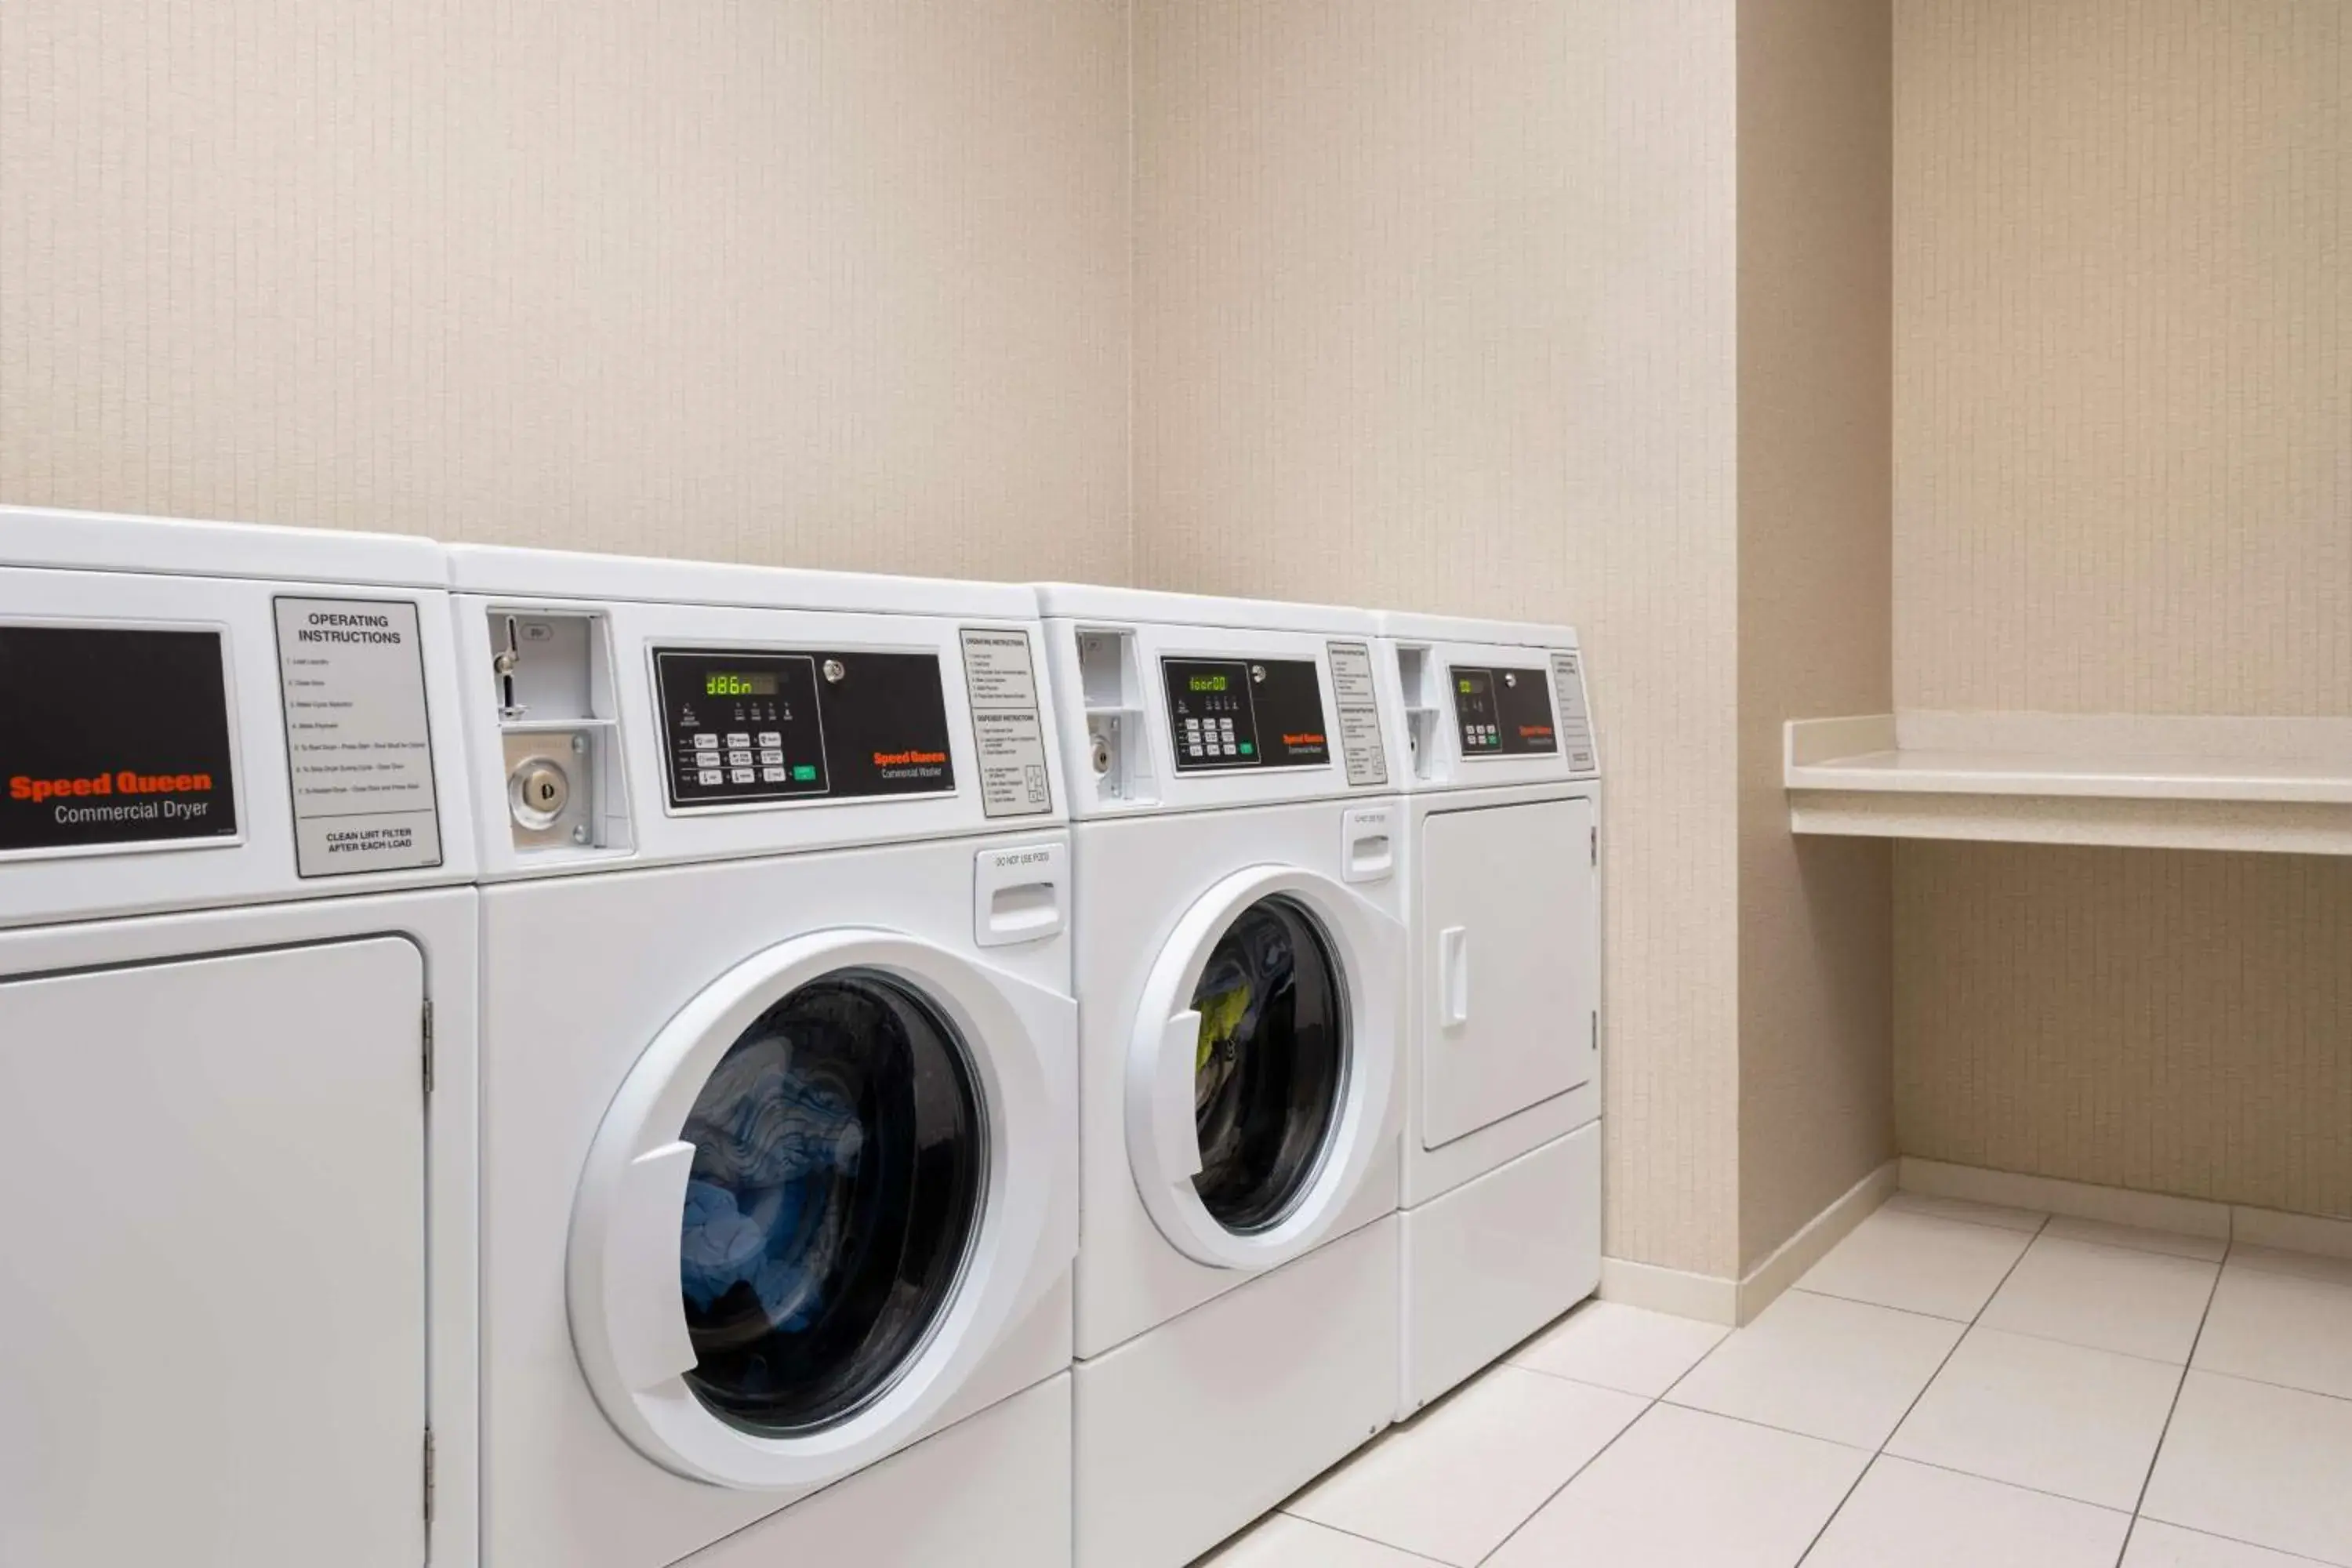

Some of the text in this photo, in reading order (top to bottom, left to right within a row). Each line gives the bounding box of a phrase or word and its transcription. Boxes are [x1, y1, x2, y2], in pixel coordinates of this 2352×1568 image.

[308, 613, 388, 627] OPERATING
[299, 630, 401, 644] INSTRUCTIONS
[873, 751, 946, 767] Speed Queen
[10, 771, 212, 803] Speed Queen
[55, 800, 209, 823] Commercial Dryer
[326, 828, 412, 841] CLEAN LINT FILTER
[328, 839, 412, 853] AFTER EACH LOAD
